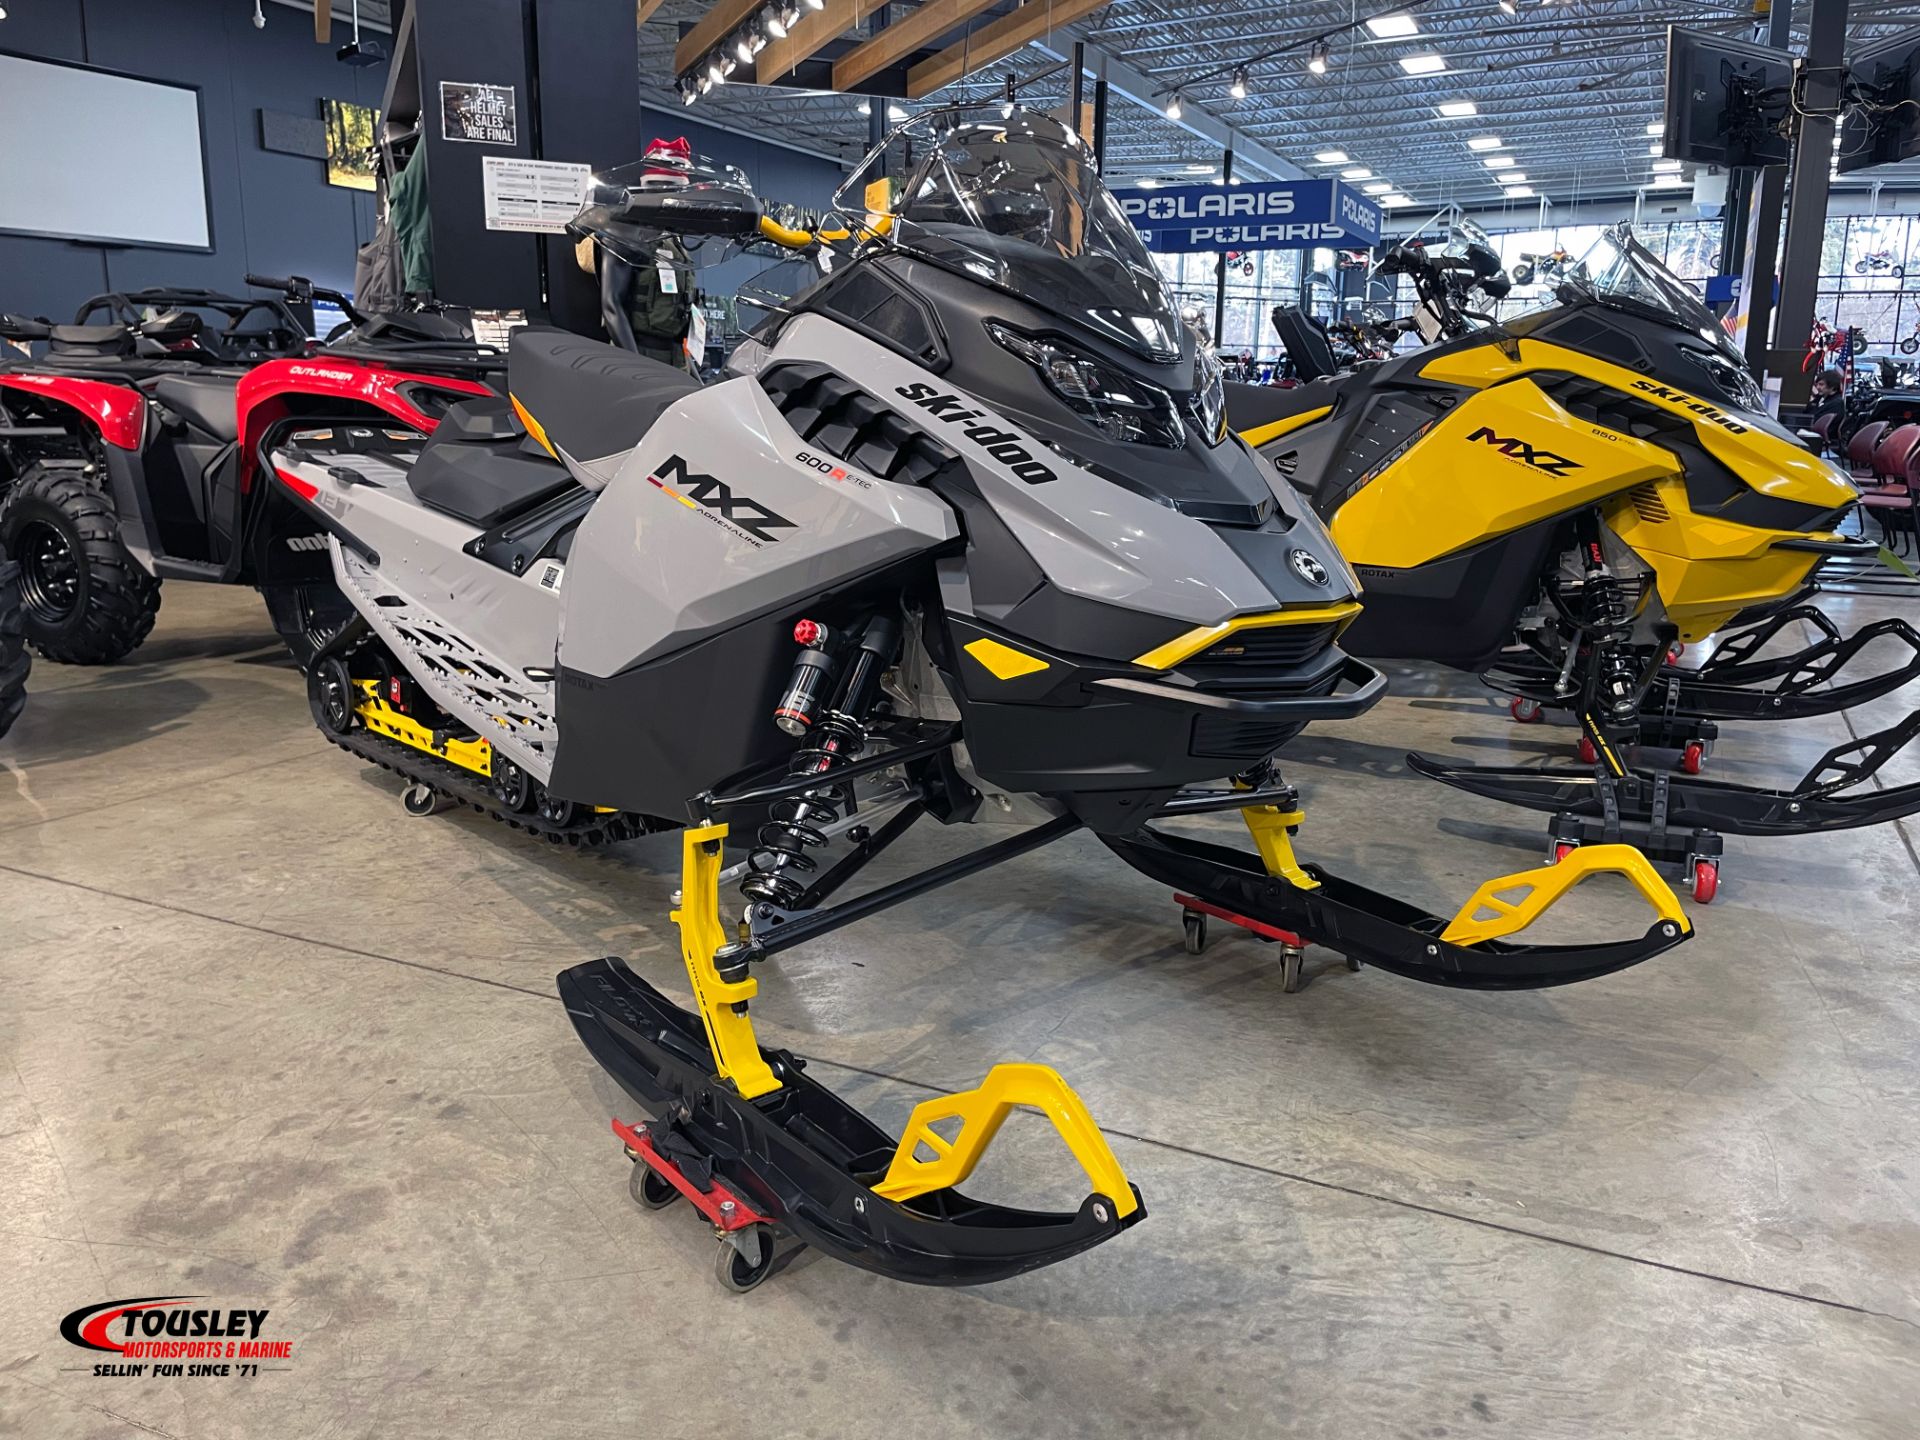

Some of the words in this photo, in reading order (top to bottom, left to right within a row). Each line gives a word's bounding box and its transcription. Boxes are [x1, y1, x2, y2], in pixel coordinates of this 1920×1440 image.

[470, 101, 506, 116] HELMET
[475, 114, 504, 128] SALES
[467, 127, 485, 139] ARE
[487, 128, 513, 142] FINAL
[1121, 191, 1295, 220] POLARIS
[1342, 194, 1376, 233] POLARIS
[1190, 223, 1346, 244] POLARIS
[710, 310, 726, 320] HERE
[289, 365, 353, 381] OUTLANDER
[895, 382, 1058, 485] ski-doo
[1592, 428, 1618, 442] 850
[1465, 426, 1585, 477] MXZ
[846, 474, 872, 490] E-TEC
[653, 453, 800, 543] MXZ
[696, 508, 764, 549] ADRENALINE
[1361, 569, 1395, 579] ROTAX
